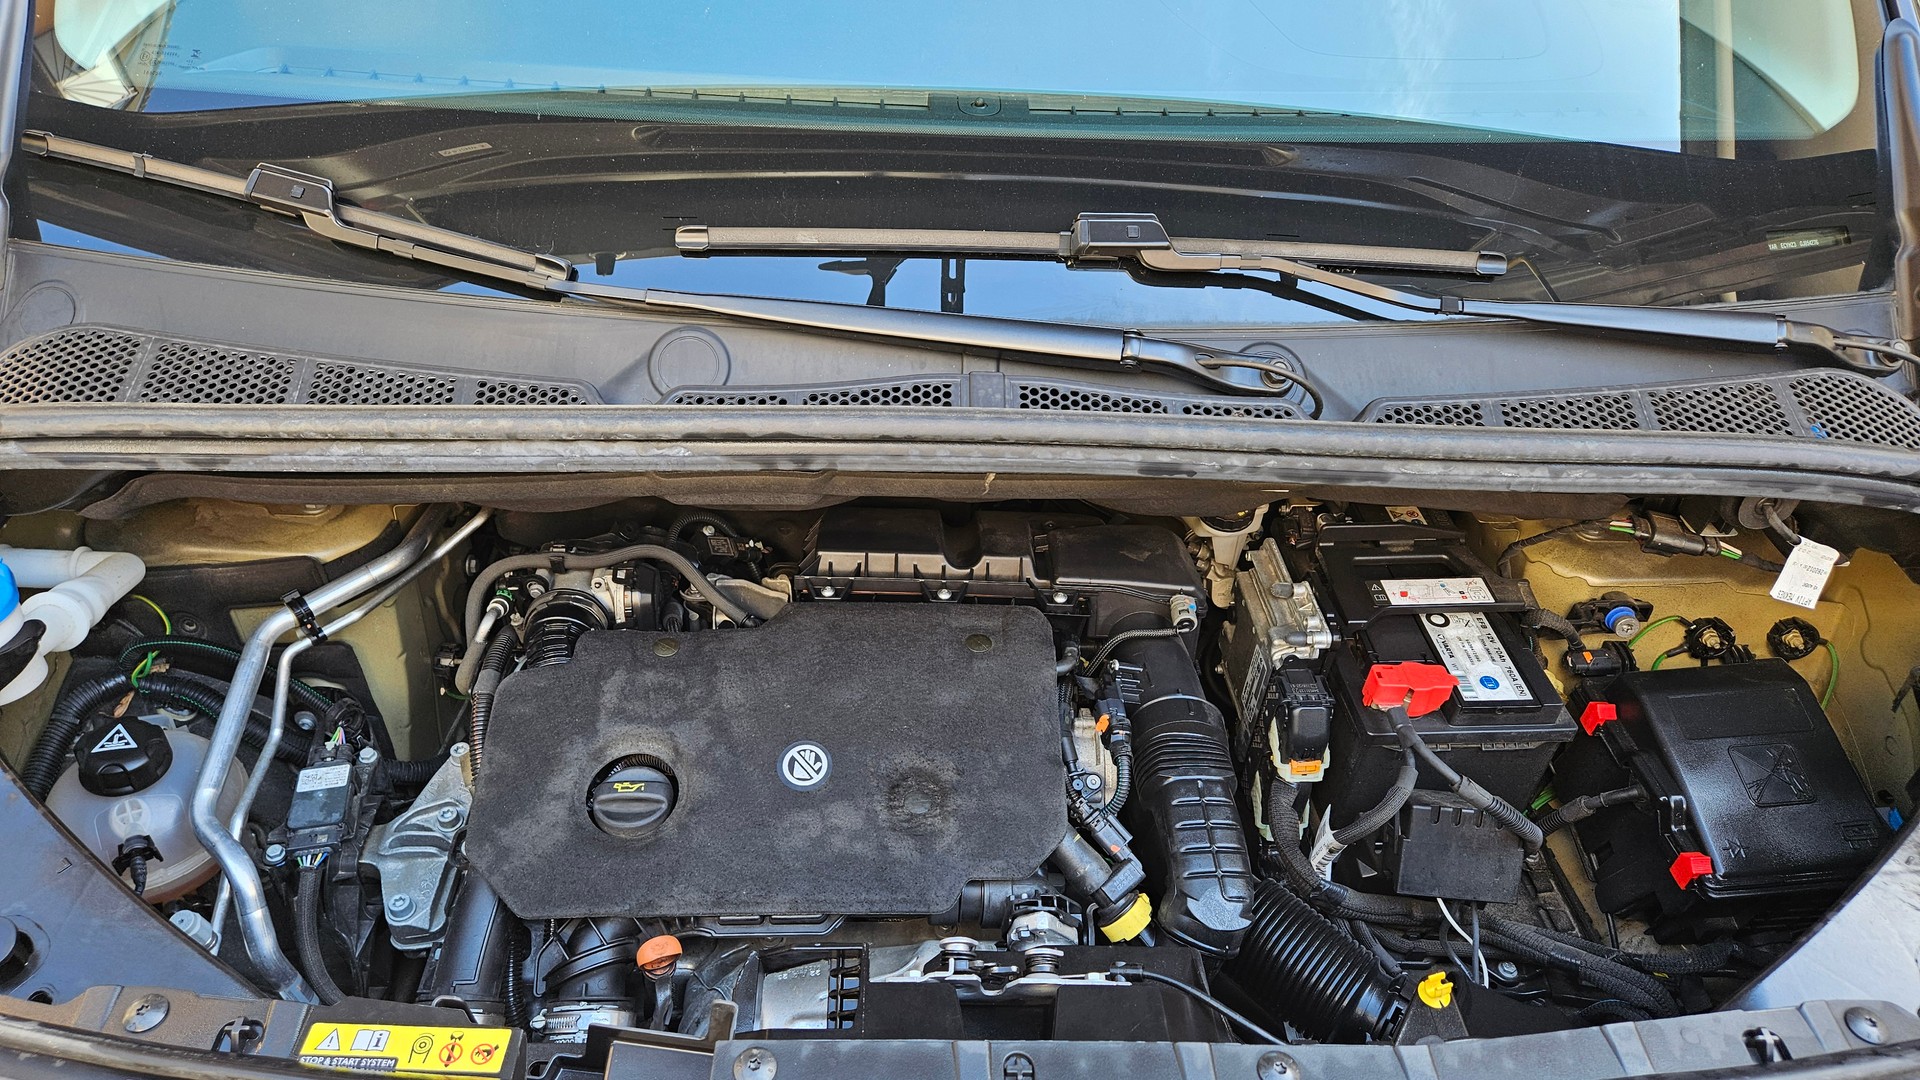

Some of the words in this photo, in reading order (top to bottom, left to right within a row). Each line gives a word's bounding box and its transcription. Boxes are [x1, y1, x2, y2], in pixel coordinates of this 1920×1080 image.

[1440, 640, 1455, 658] VARTA
[1476, 617, 1487, 628] EFB
[1484, 633, 1496, 643] 12V
[1493, 647, 1507, 662] 70Ah
[1504, 666, 1518, 681] 760A
[1514, 683, 1527, 696] (EN)
[300, 1056, 324, 1064] STOP
[332, 1057, 362, 1066] START
[362, 1058, 395, 1067] SYSTEM
